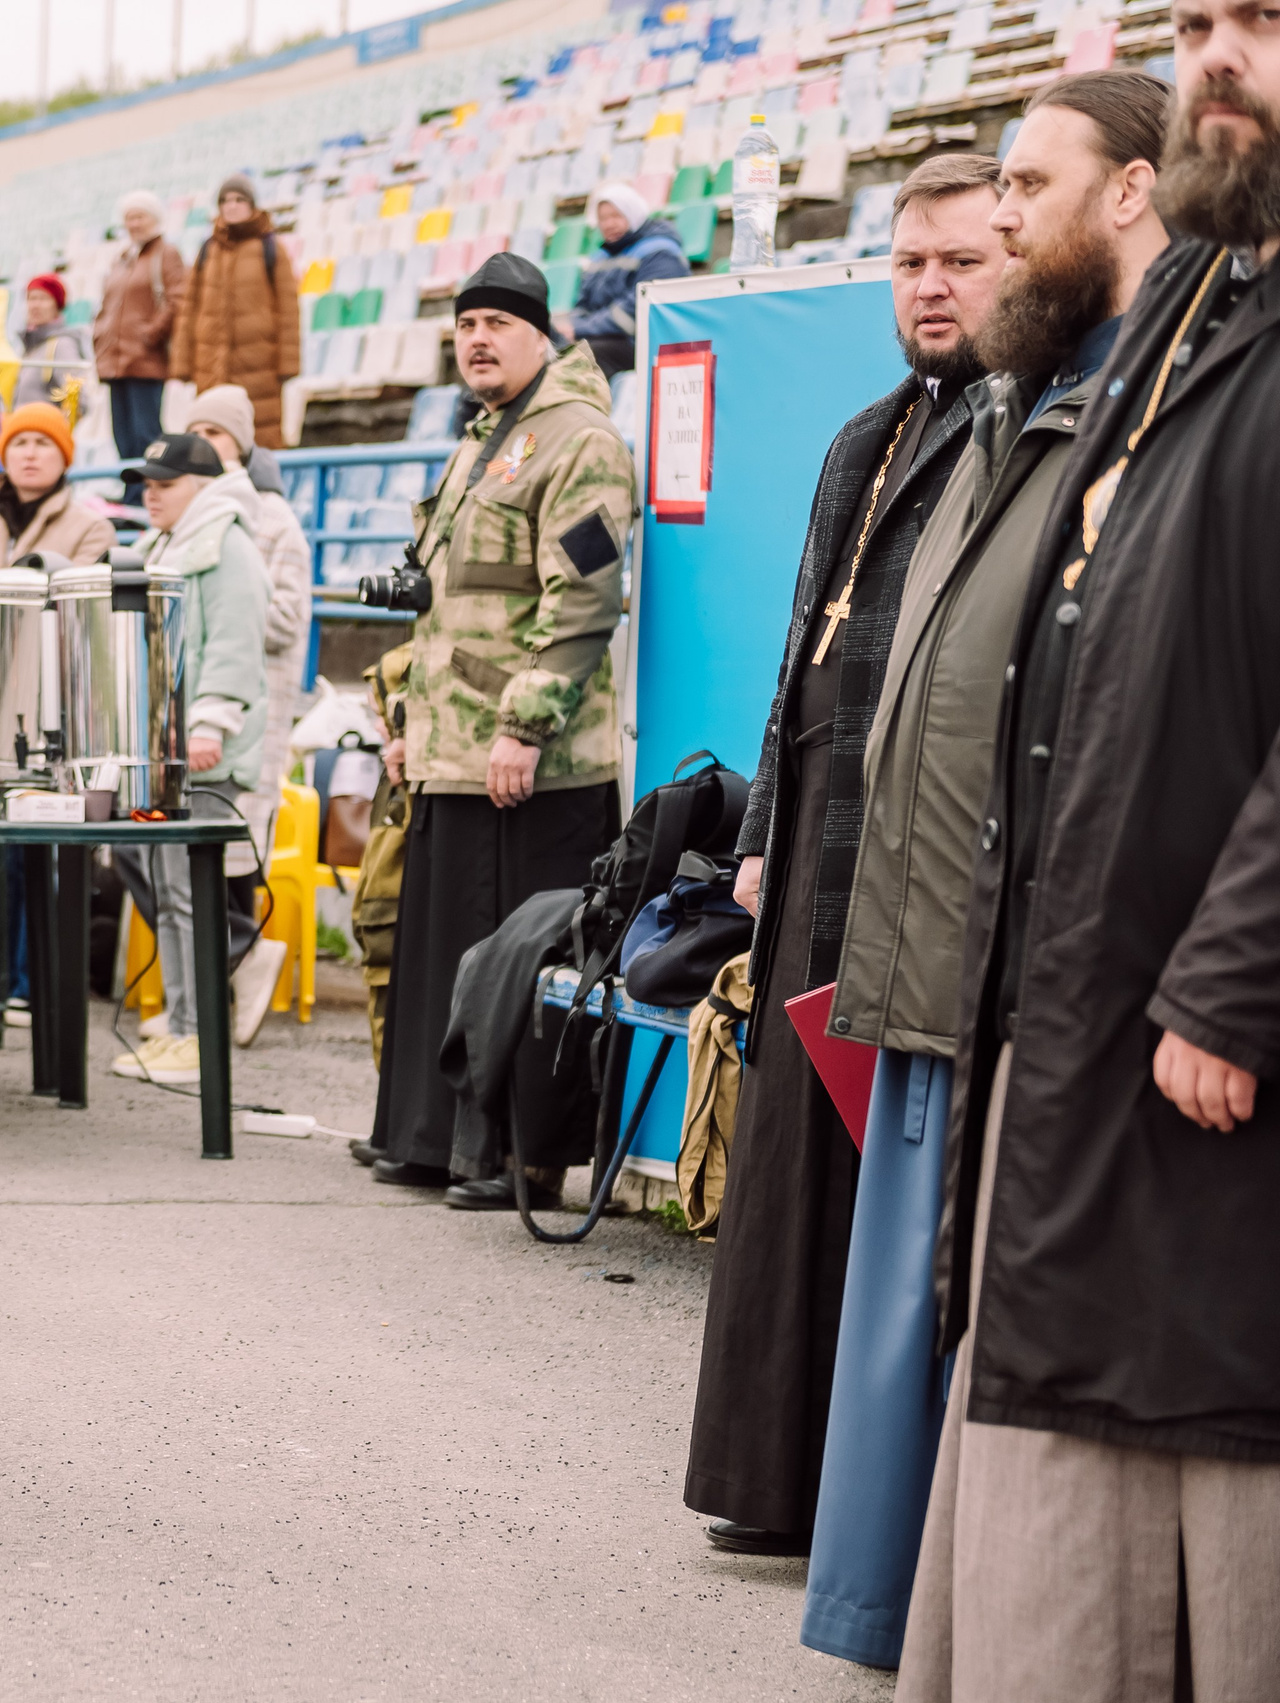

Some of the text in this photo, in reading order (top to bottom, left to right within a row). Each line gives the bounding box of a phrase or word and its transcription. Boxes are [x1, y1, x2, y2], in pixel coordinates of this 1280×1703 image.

[667, 379, 704, 396] ТУАЛЕТ
[678, 405, 691, 420] НА
[667, 429, 701, 444] УЛИЦЕ
